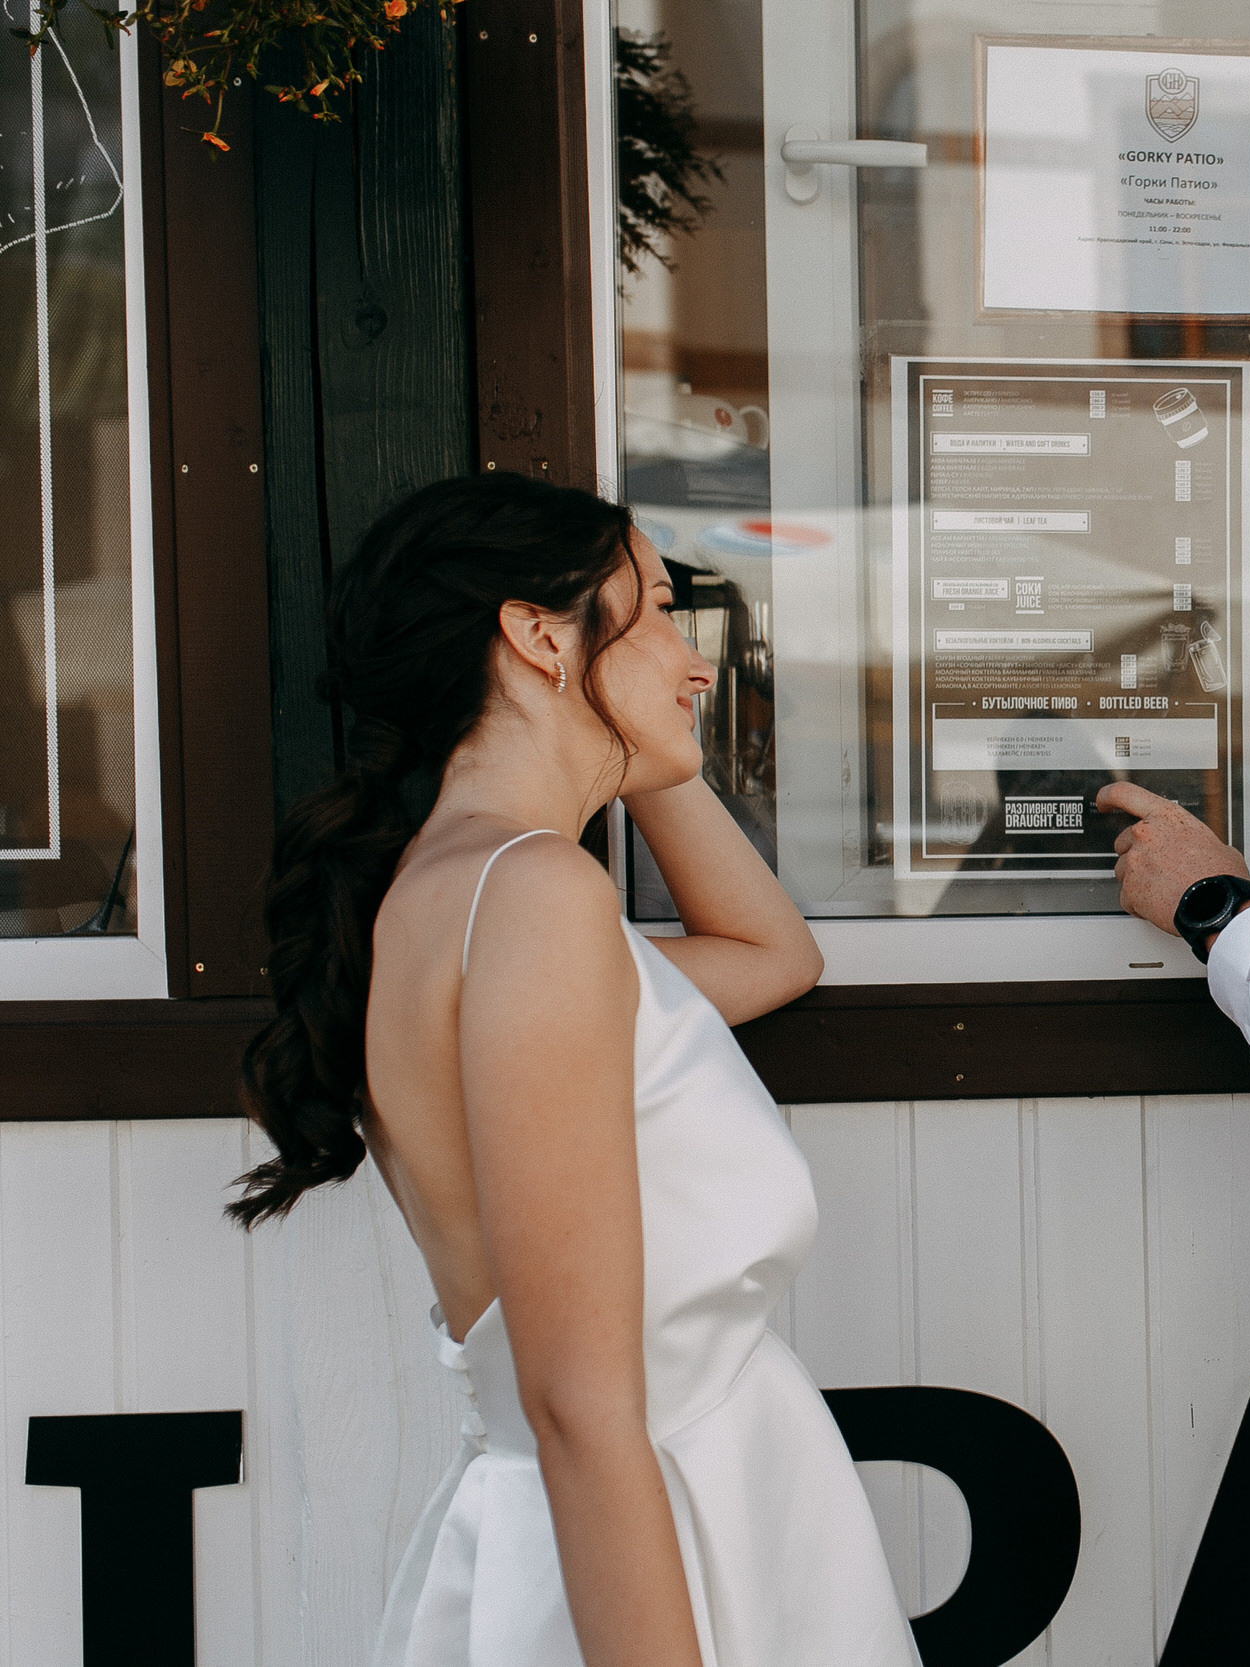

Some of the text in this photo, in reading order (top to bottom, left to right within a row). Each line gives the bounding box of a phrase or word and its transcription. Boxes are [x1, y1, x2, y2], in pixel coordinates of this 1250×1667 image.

[1118, 151, 1224, 165] «GORKY PATIO»
[1120, 175, 1218, 190] «Горки Патио»
[932, 393, 953, 403] КОФЕ
[932, 403, 953, 413] COFFEE
[1015, 582, 1041, 595] СОКИ
[1015, 596, 1041, 608] JUICE
[982, 696, 1078, 709] БУТЫЛОЧНОЕ ПИВО
[1099, 696, 1169, 709] BOTTLED BEER
[1005, 802, 1058, 814] РАЗЛИВНОЕ
[1059, 802, 1083, 814] ПИВО
[1005, 814, 1083, 827] DRAUGHT BEER
